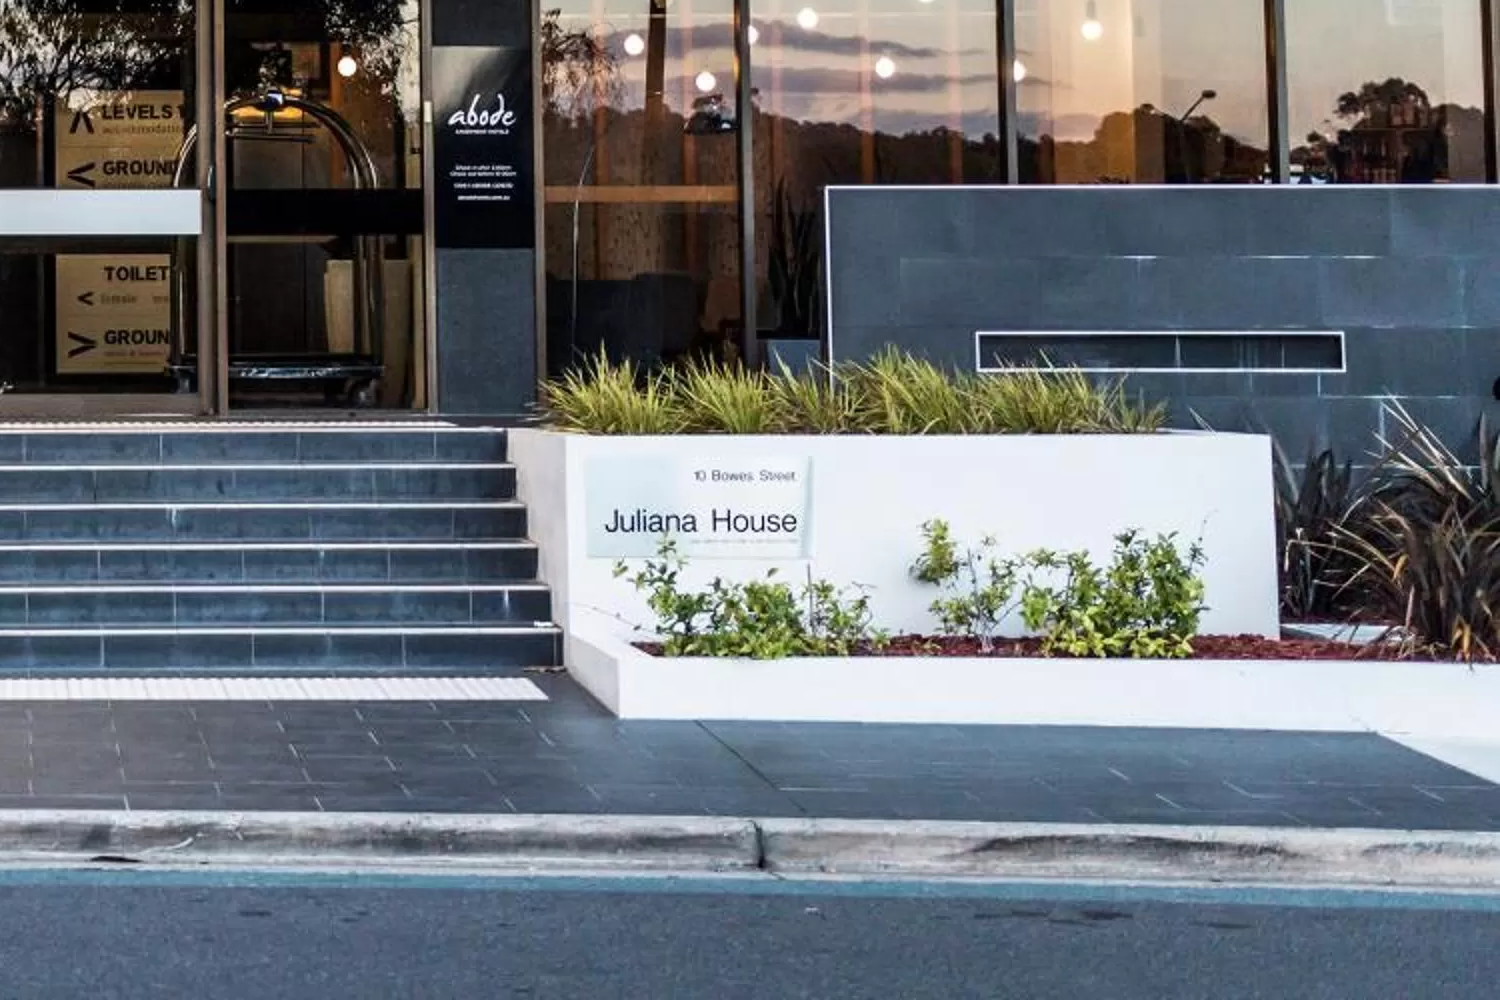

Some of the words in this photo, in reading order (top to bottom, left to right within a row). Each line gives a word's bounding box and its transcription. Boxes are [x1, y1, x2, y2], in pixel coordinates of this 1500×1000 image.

[101, 104, 173, 120] LEVELS
[447, 93, 517, 127] abode
[104, 329, 169, 345] GROUN
[694, 469, 707, 482] 10
[711, 469, 755, 482] Bowes
[759, 469, 797, 482] Street
[604, 508, 699, 533] Juliana
[711, 507, 798, 533] House
